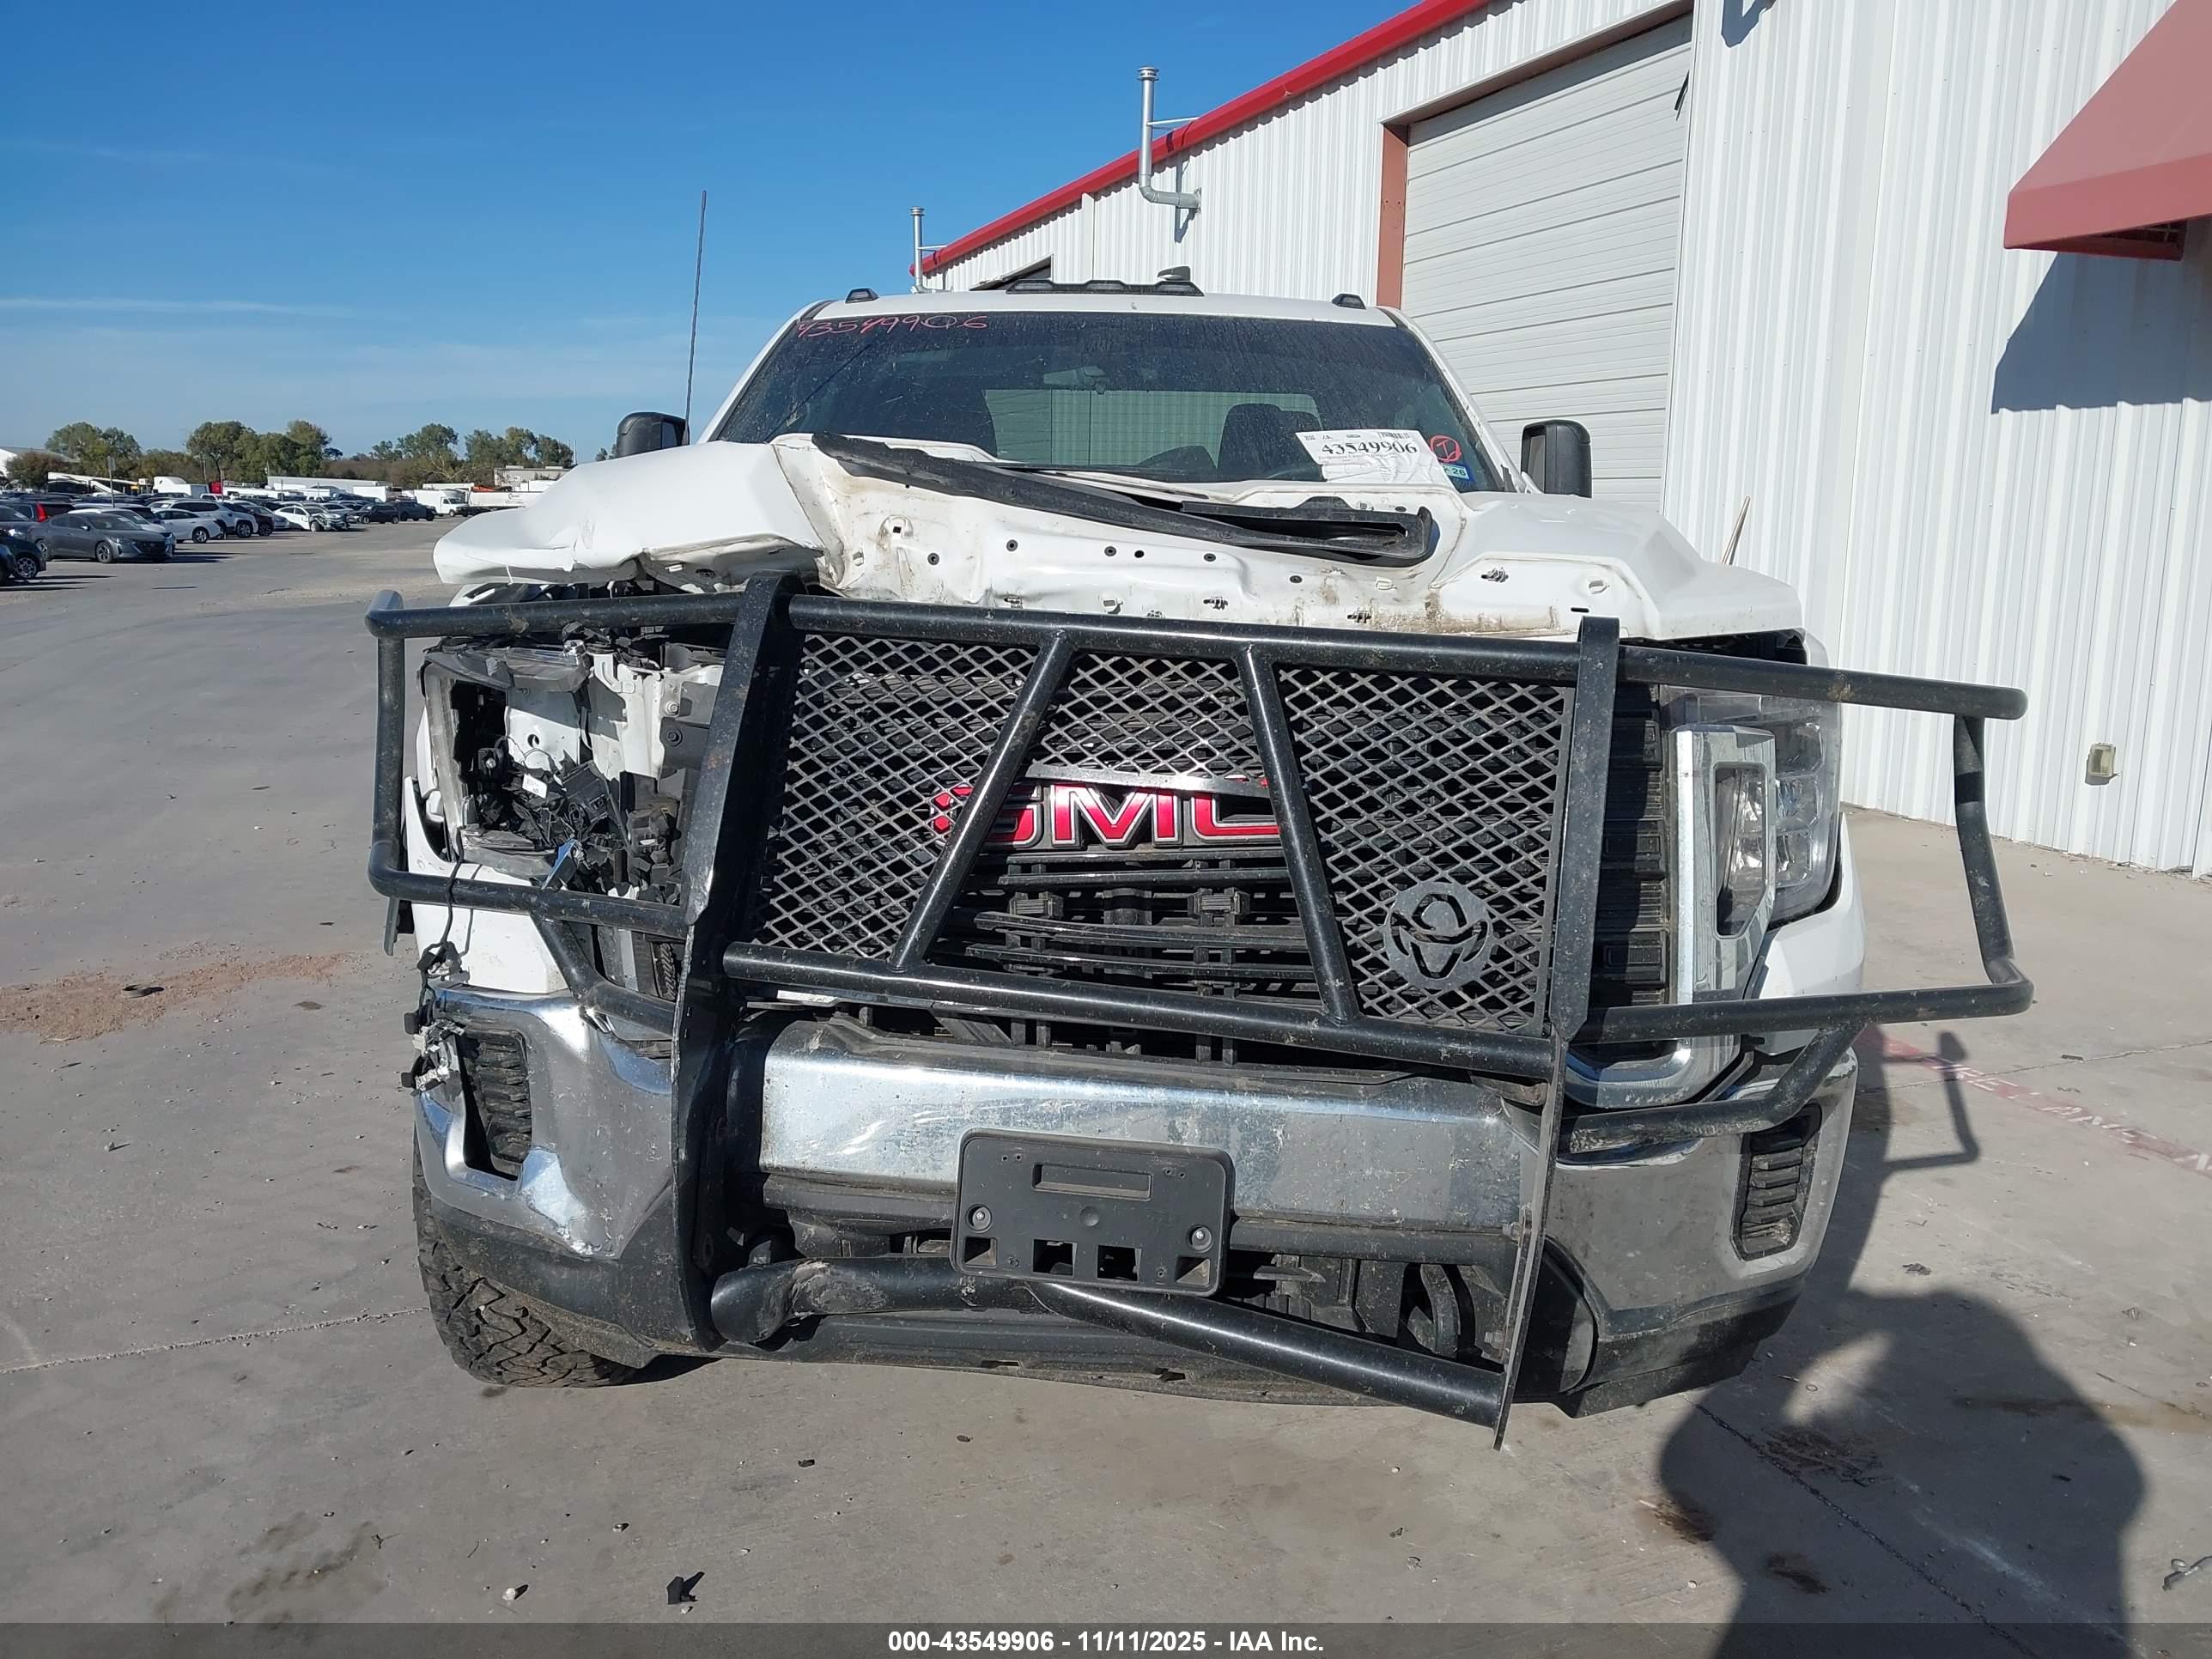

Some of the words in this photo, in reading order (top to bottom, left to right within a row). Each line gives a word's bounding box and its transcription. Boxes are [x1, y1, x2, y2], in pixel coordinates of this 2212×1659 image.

[798, 315, 988, 337] 43549906
[1322, 441, 1418, 454] 43549906
[1451, 467, 1467, 477] 26
